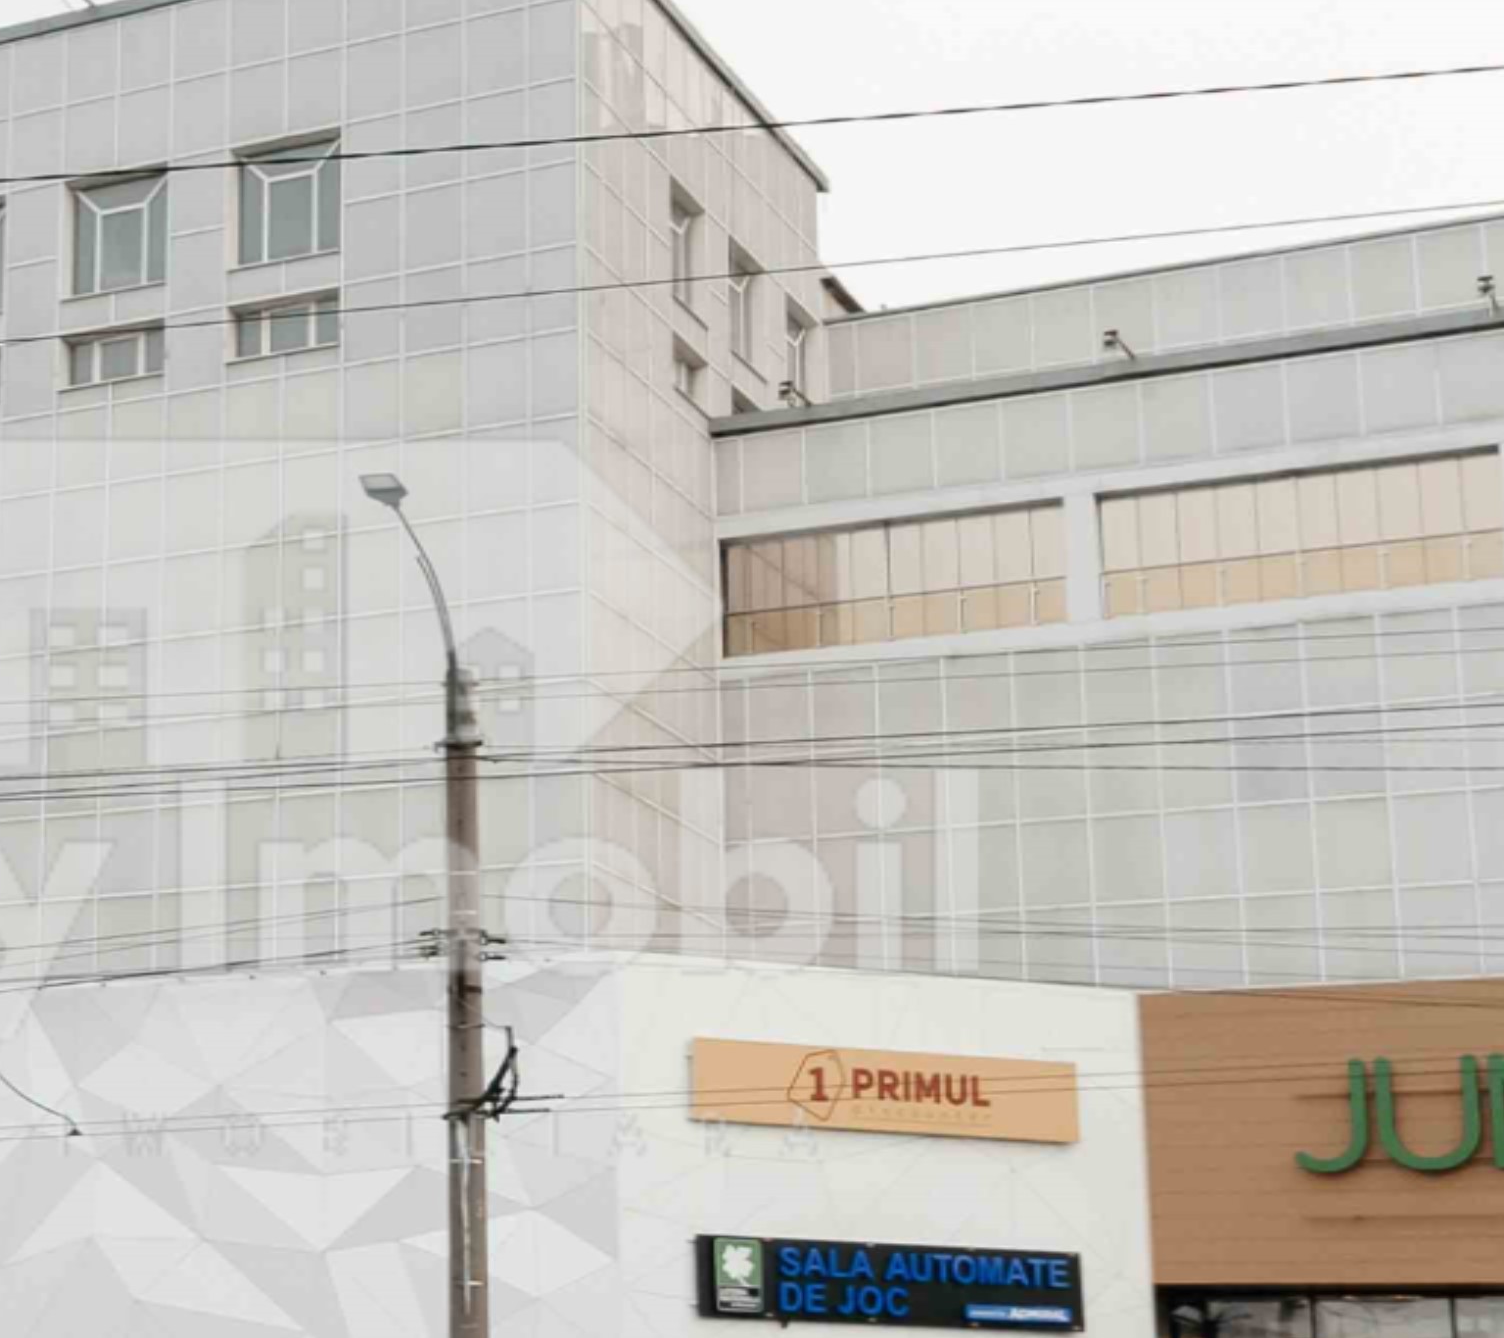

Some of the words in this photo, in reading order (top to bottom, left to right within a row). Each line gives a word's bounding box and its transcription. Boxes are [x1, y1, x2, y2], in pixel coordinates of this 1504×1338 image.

[809, 1067, 830, 1102] 1
[851, 1068, 991, 1107] PRIMUL
[778, 1245, 875, 1279] SALA
[886, 1251, 1073, 1289] AUTOMATE
[777, 1281, 828, 1314] DE
[836, 1285, 910, 1318] JOC
